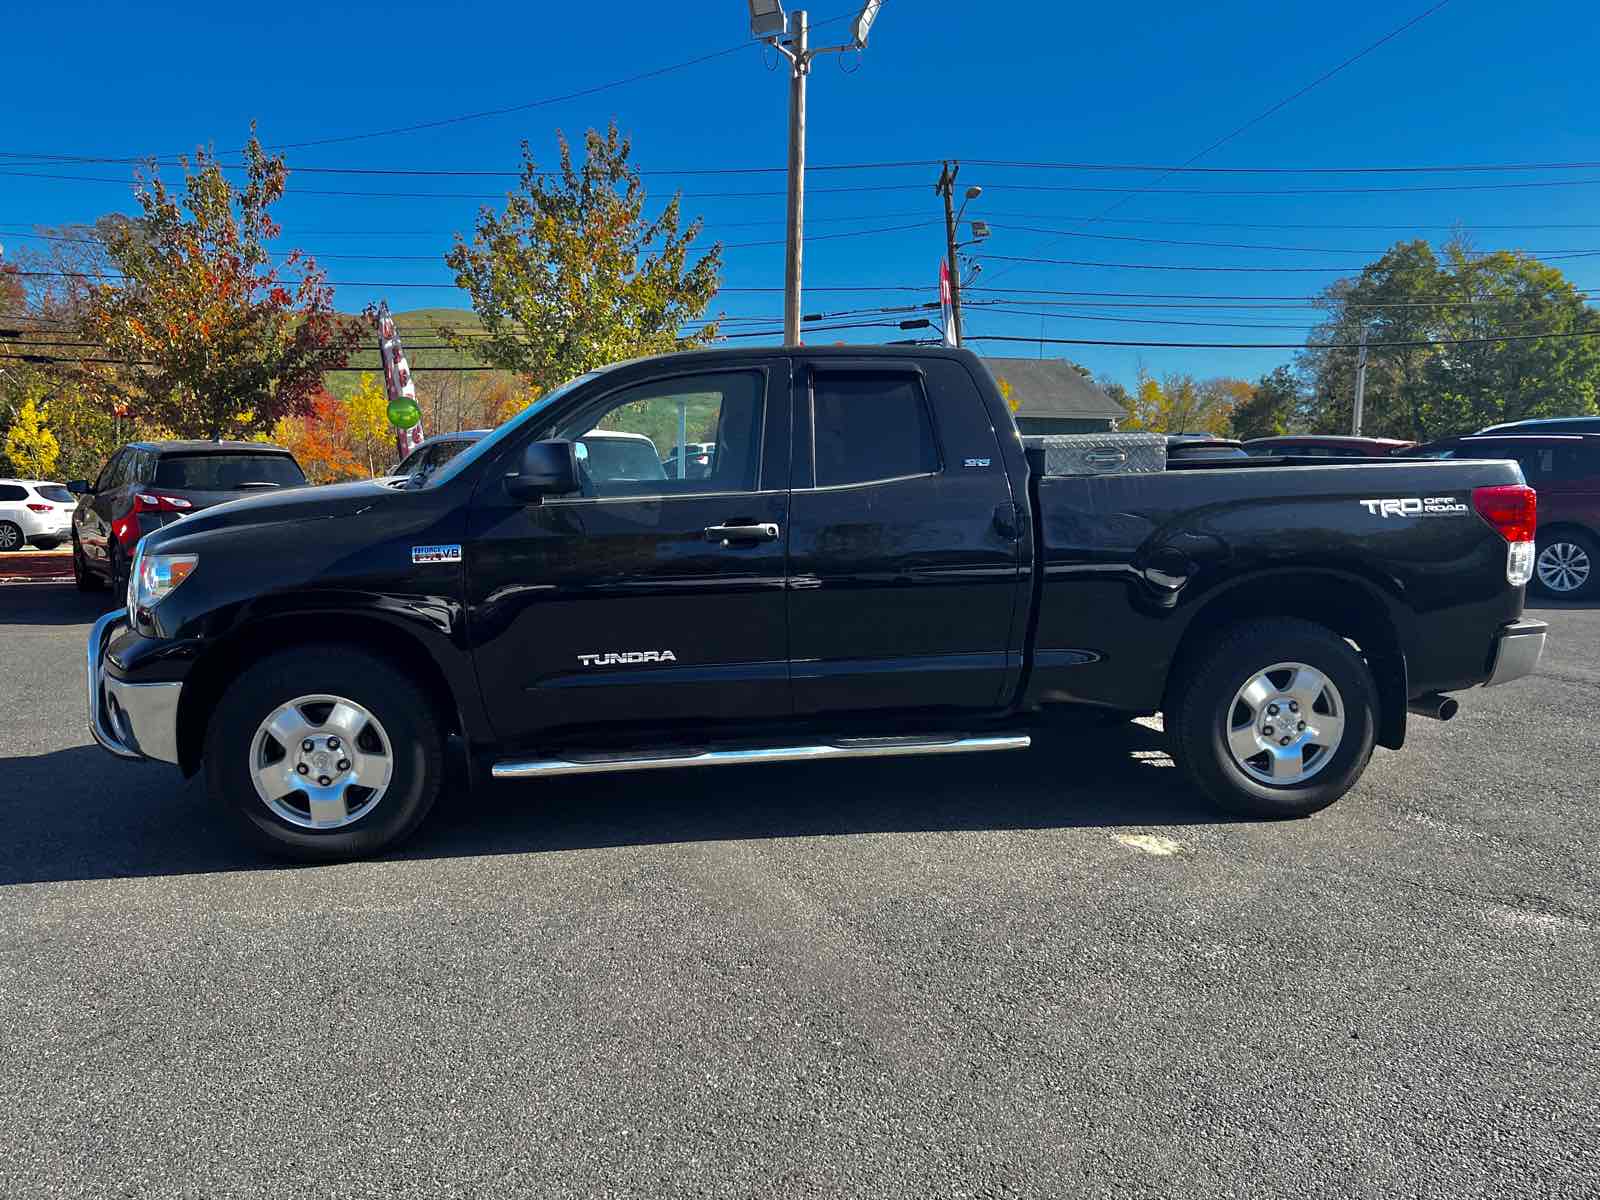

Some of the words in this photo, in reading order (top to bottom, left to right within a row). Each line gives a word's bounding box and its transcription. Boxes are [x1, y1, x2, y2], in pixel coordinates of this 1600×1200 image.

[1360, 498, 1422, 518] TRD
[1424, 497, 1456, 505] OFF
[1425, 504, 1468, 513] ROAD
[577, 650, 677, 666] TUNDRA
